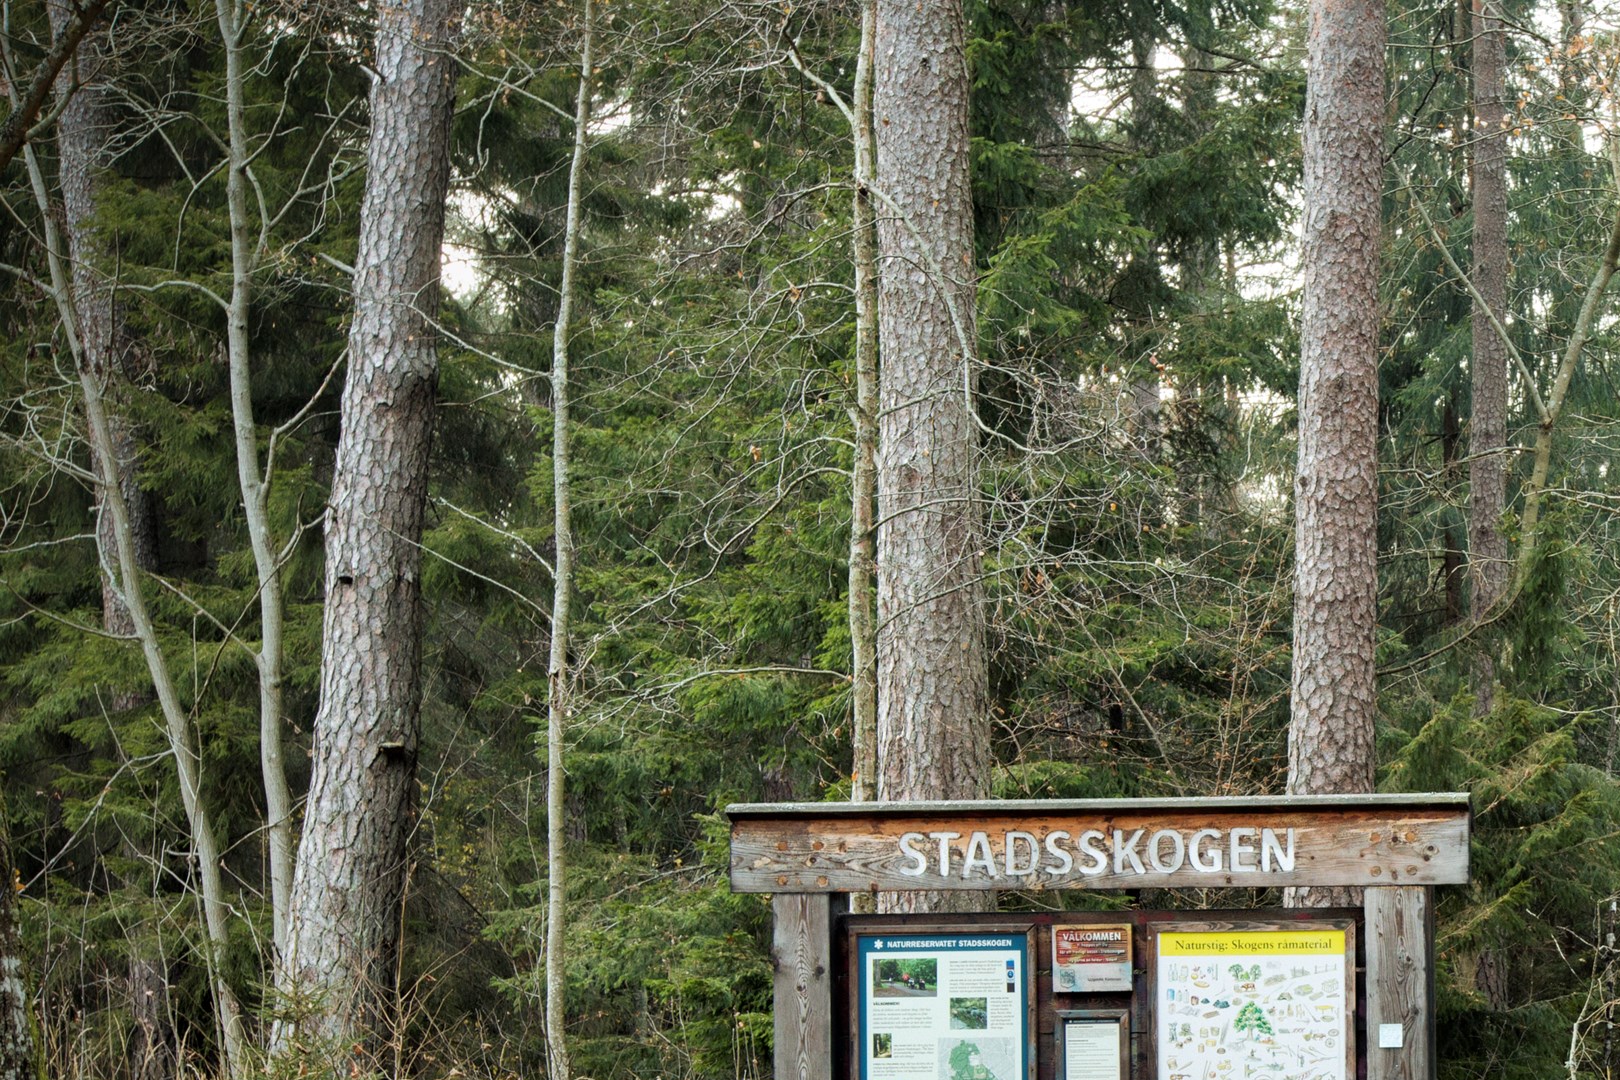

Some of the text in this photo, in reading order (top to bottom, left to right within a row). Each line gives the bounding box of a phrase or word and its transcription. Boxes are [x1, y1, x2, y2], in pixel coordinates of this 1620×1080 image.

[899, 827, 1296, 877] STADSSKOGEN
[1062, 931, 1121, 942] VÄLKOMMEN
[887, 939, 1011, 948] NATURRESERVATET STADSSKOGEN
[1175, 938, 1332, 952] Naturstig: Skogens råmaterial
